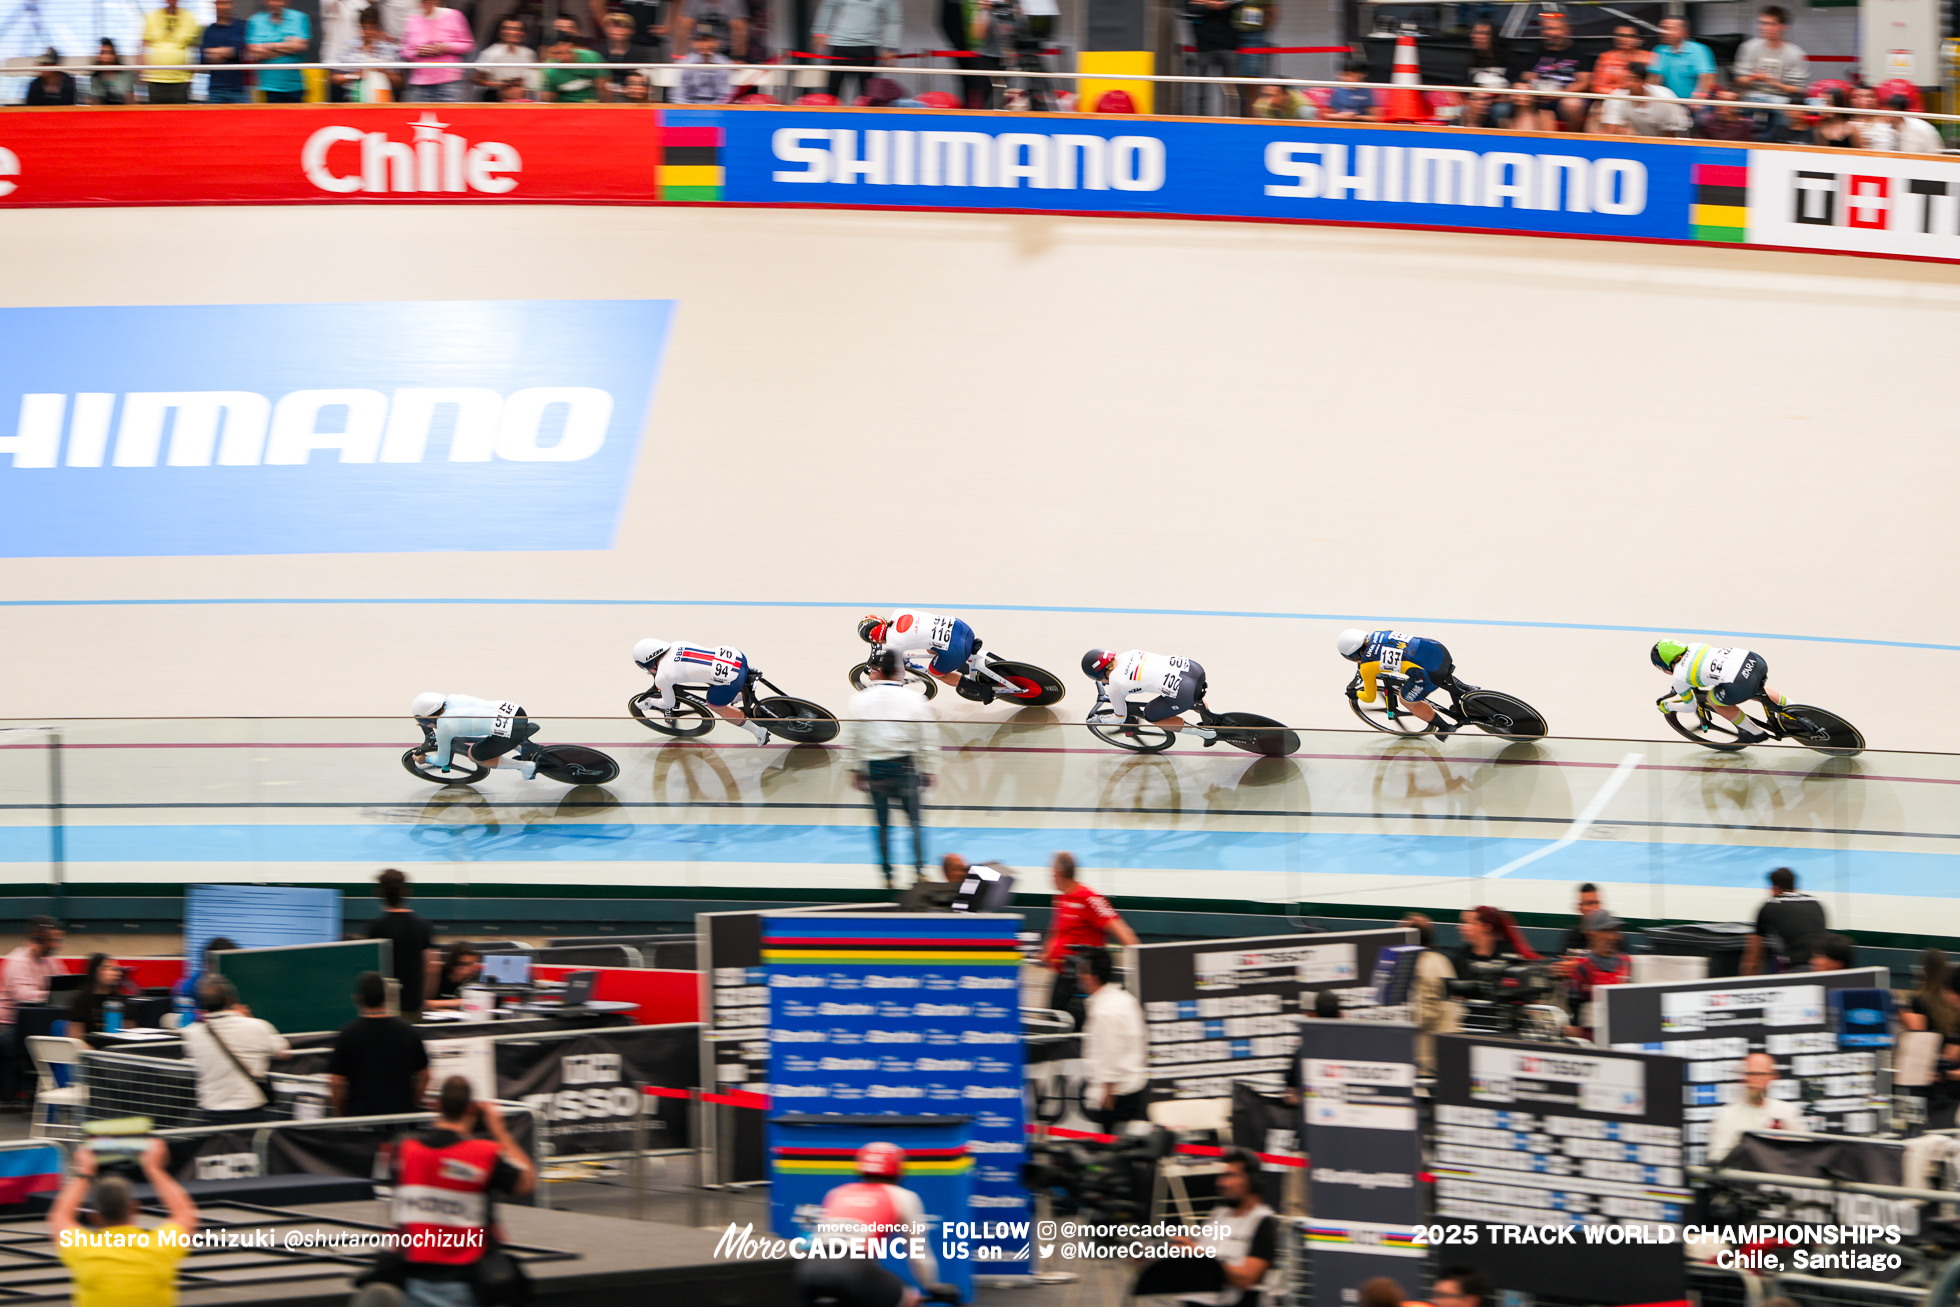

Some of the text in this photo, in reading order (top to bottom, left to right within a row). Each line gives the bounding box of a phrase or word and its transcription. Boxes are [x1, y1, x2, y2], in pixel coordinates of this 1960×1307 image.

[302, 113, 522, 194] Chile
[771, 127, 1166, 192] SHIMANO
[1264, 140, 1648, 217] SHIMANO
[931, 628, 950, 643] 116
[645, 648, 664, 661] LAZER
[1381, 650, 1402, 666] 137
[714, 663, 729, 678] 94
